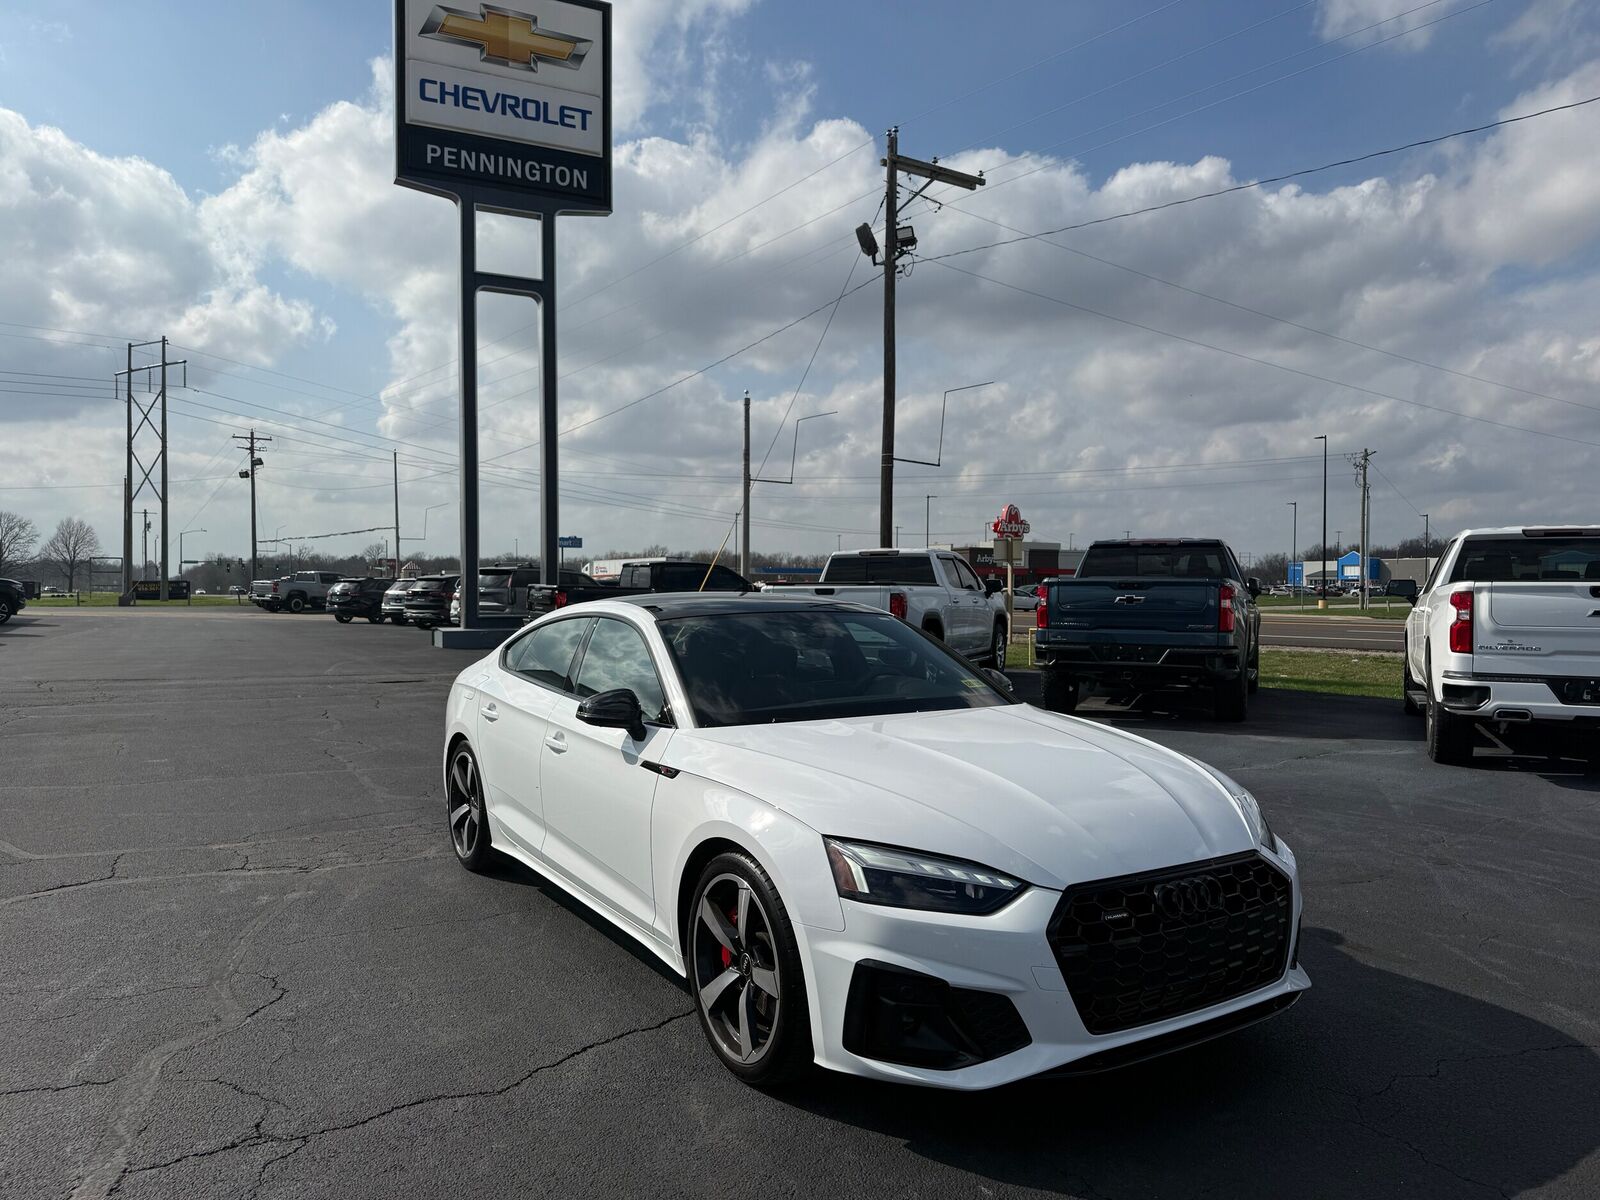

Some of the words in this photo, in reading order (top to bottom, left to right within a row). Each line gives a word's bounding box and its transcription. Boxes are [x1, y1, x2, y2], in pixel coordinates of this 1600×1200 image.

[419, 78, 593, 131] CHEVROLET
[426, 143, 588, 190] PENNINGTON
[1478, 644, 1542, 652] SILVERADO
